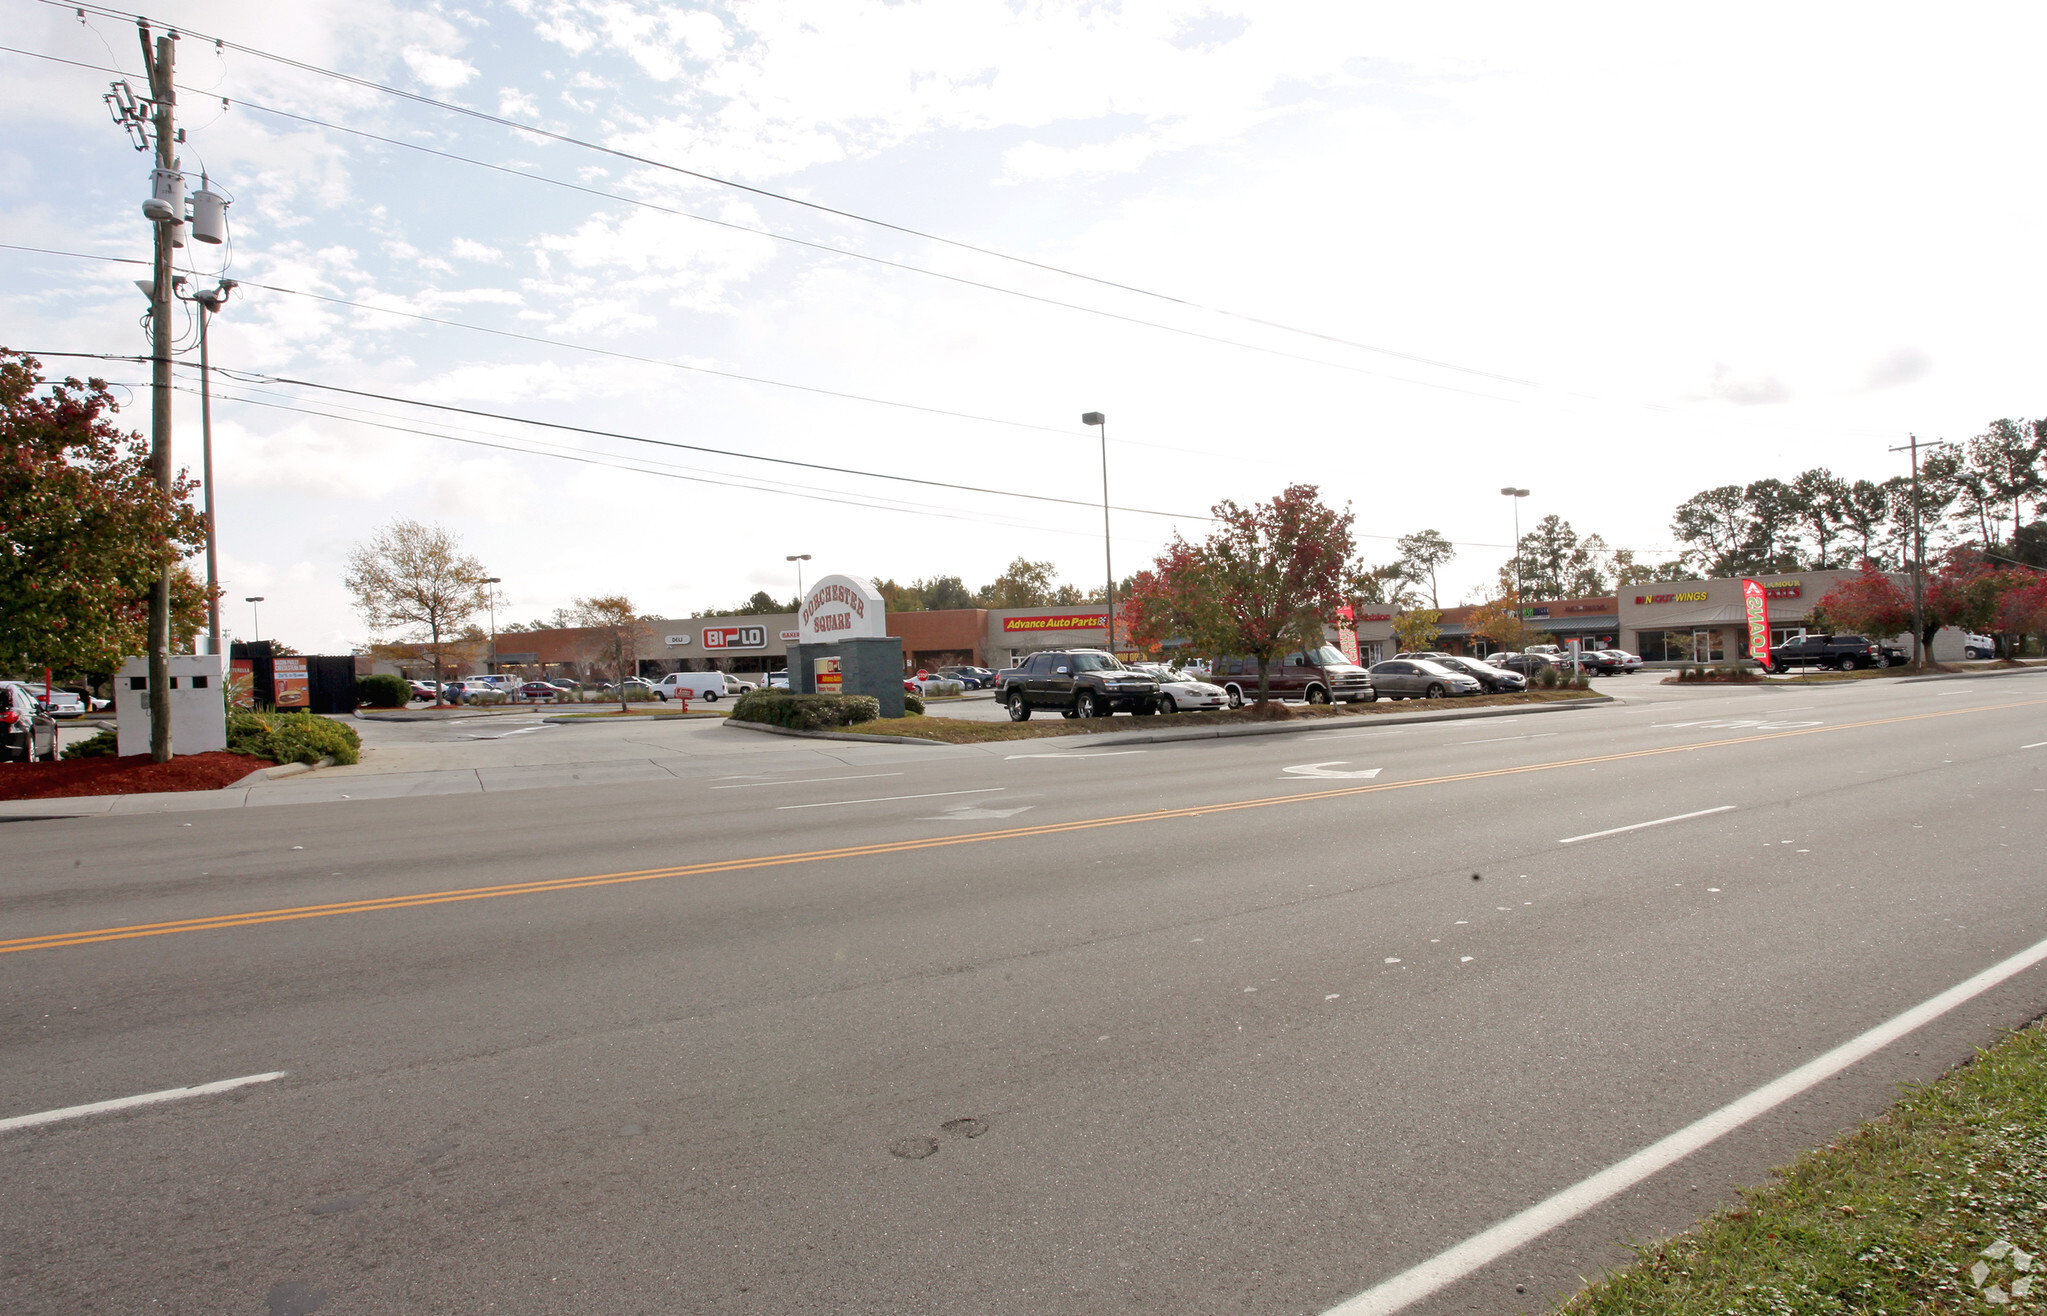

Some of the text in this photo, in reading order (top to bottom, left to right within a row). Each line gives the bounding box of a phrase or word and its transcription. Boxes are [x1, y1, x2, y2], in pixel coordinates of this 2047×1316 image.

[1761, 580, 1801, 589] LAMOUR
[1675, 591, 1708, 602] WINGS
[803, 585, 864, 626] DORCHESTER
[814, 612, 851, 633] SQUARE
[1006, 617, 1098, 629] Advance Auto Parts
[1129, 652, 1148, 662] OPN
